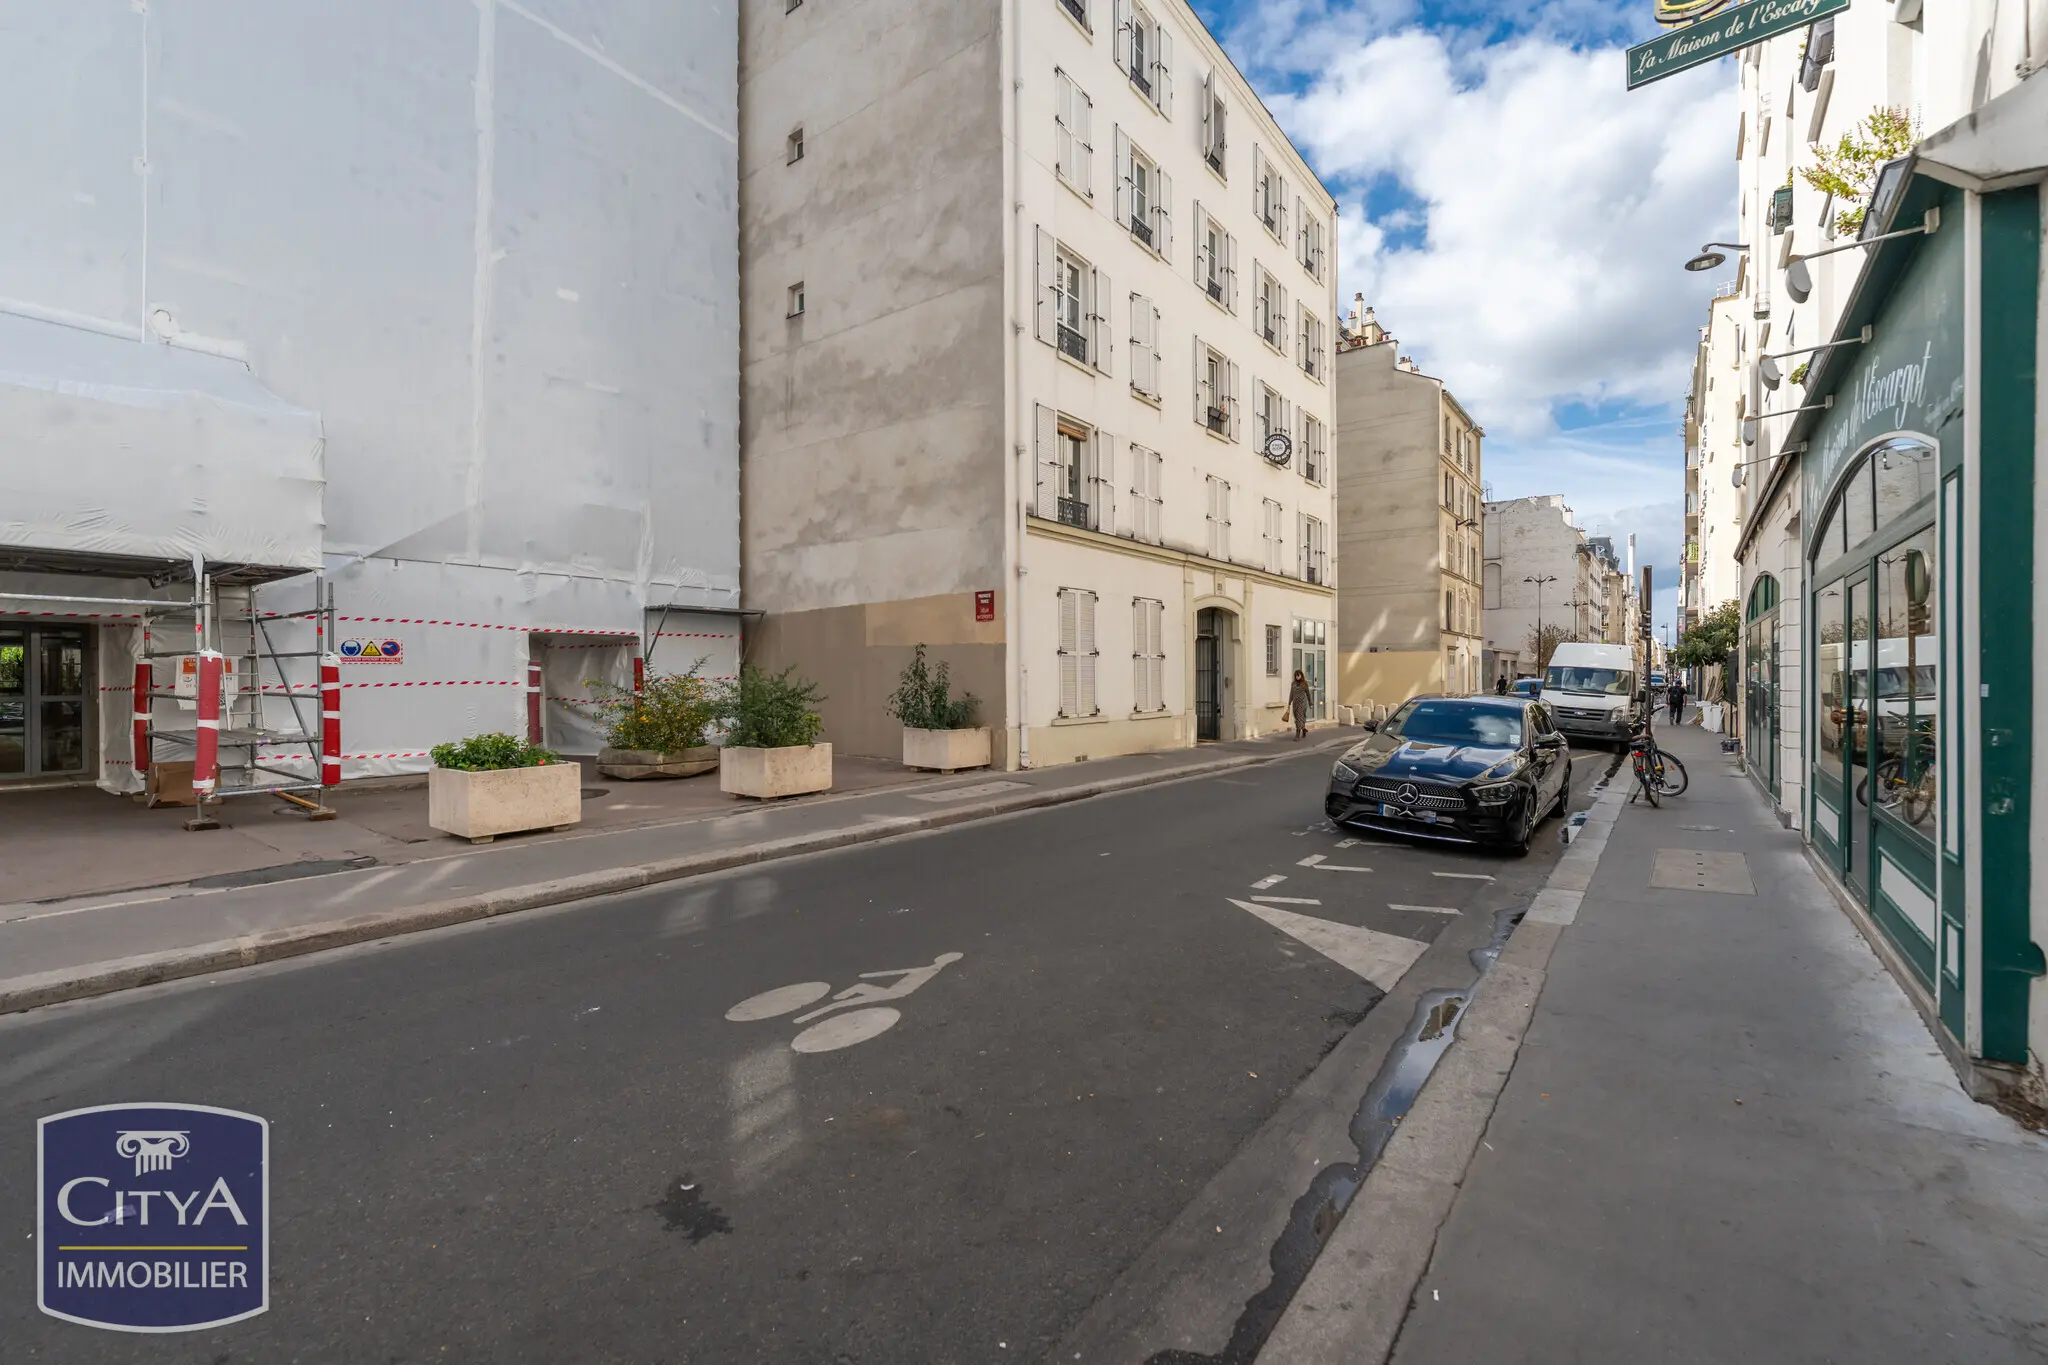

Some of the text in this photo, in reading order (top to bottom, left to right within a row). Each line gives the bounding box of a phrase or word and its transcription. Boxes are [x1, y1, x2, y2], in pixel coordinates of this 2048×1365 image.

[1633, 0, 1826, 75] La Maison de l'Escarg
[1861, 340, 1931, 430] l'Escargot
